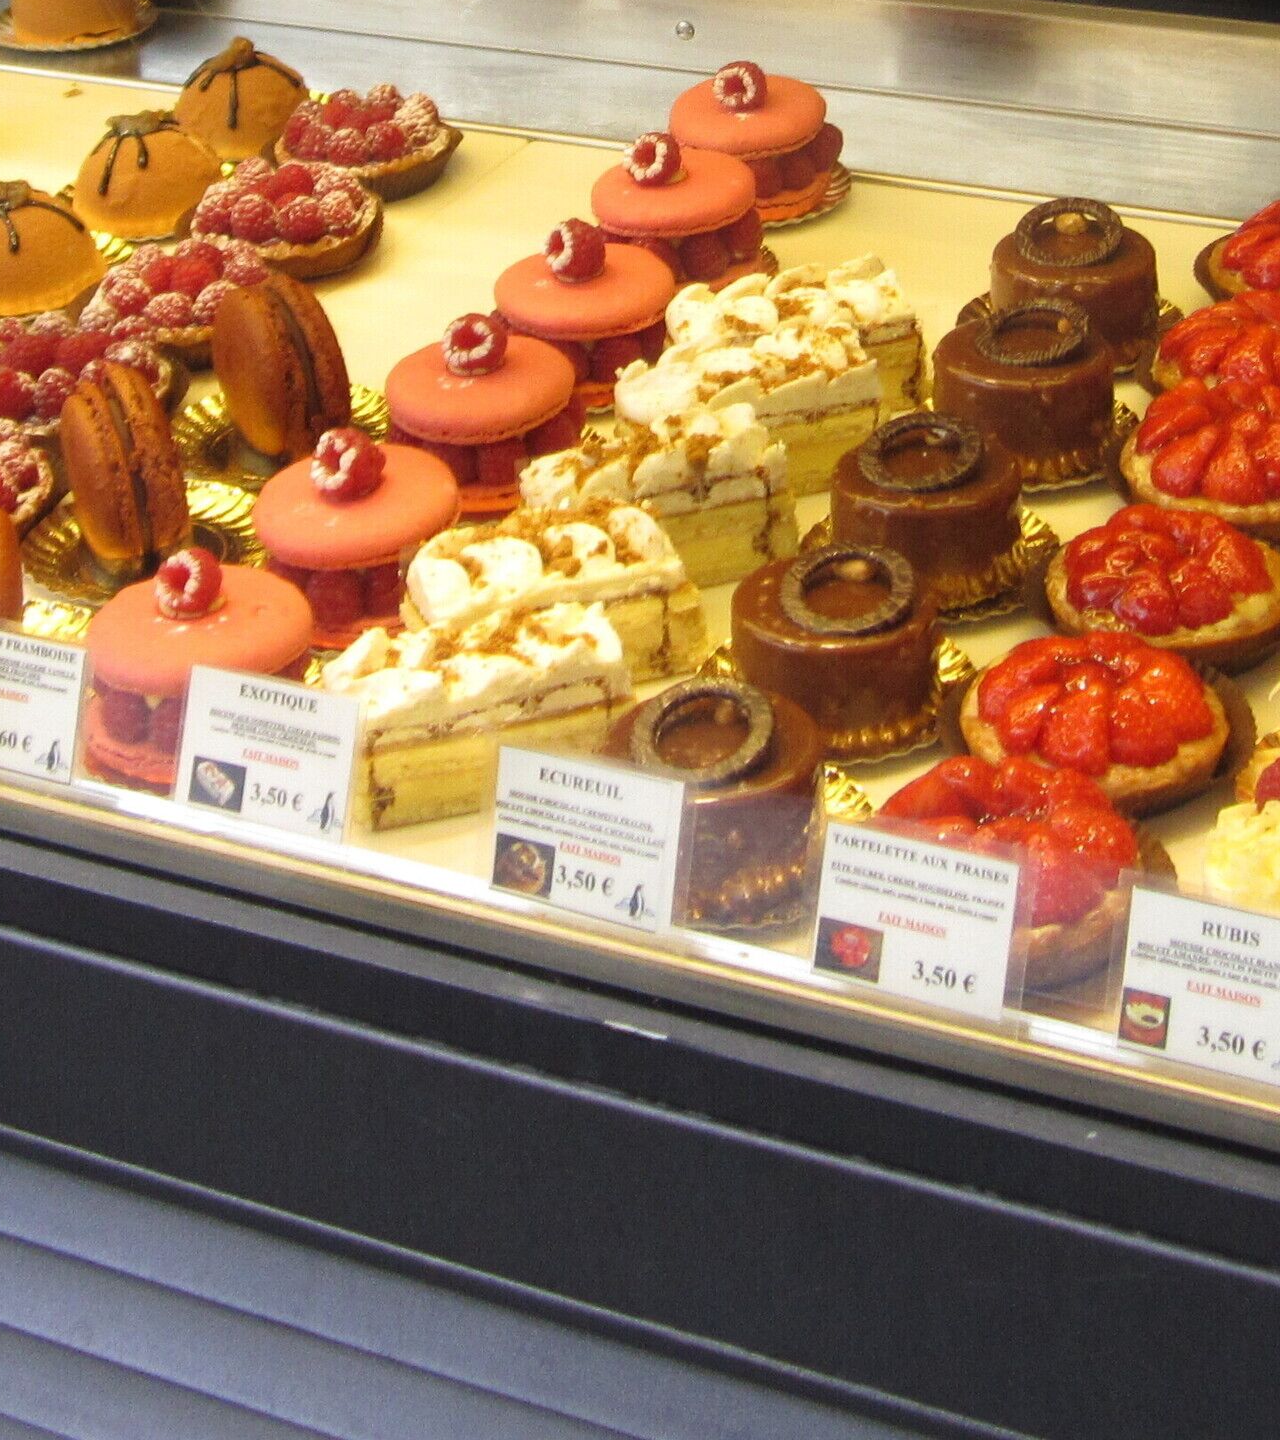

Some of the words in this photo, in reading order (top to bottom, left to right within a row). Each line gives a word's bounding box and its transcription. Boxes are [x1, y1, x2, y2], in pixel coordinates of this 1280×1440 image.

[6, 639, 76, 664] FRAMBOISE
[239, 682, 318, 715] EXOTIQUE
[22, 735, 32, 753] €
[250, 781, 287, 810] 3,50
[291, 792, 303, 812] €
[539, 766, 624, 800] ECUREUIL
[833, 832, 917, 862] TARTELETTE
[923, 855, 948, 870] AUX
[955, 862, 1009, 884] FRAISES
[555, 864, 596, 893] 3,50
[602, 876, 615, 897] €
[1201, 919, 1261, 947] RUBIS
[912, 960, 957, 989] 3,50
[962, 973, 977, 994] €
[1196, 1024, 1245, 1059] 3,50
[1251, 1037, 1266, 1062] €
